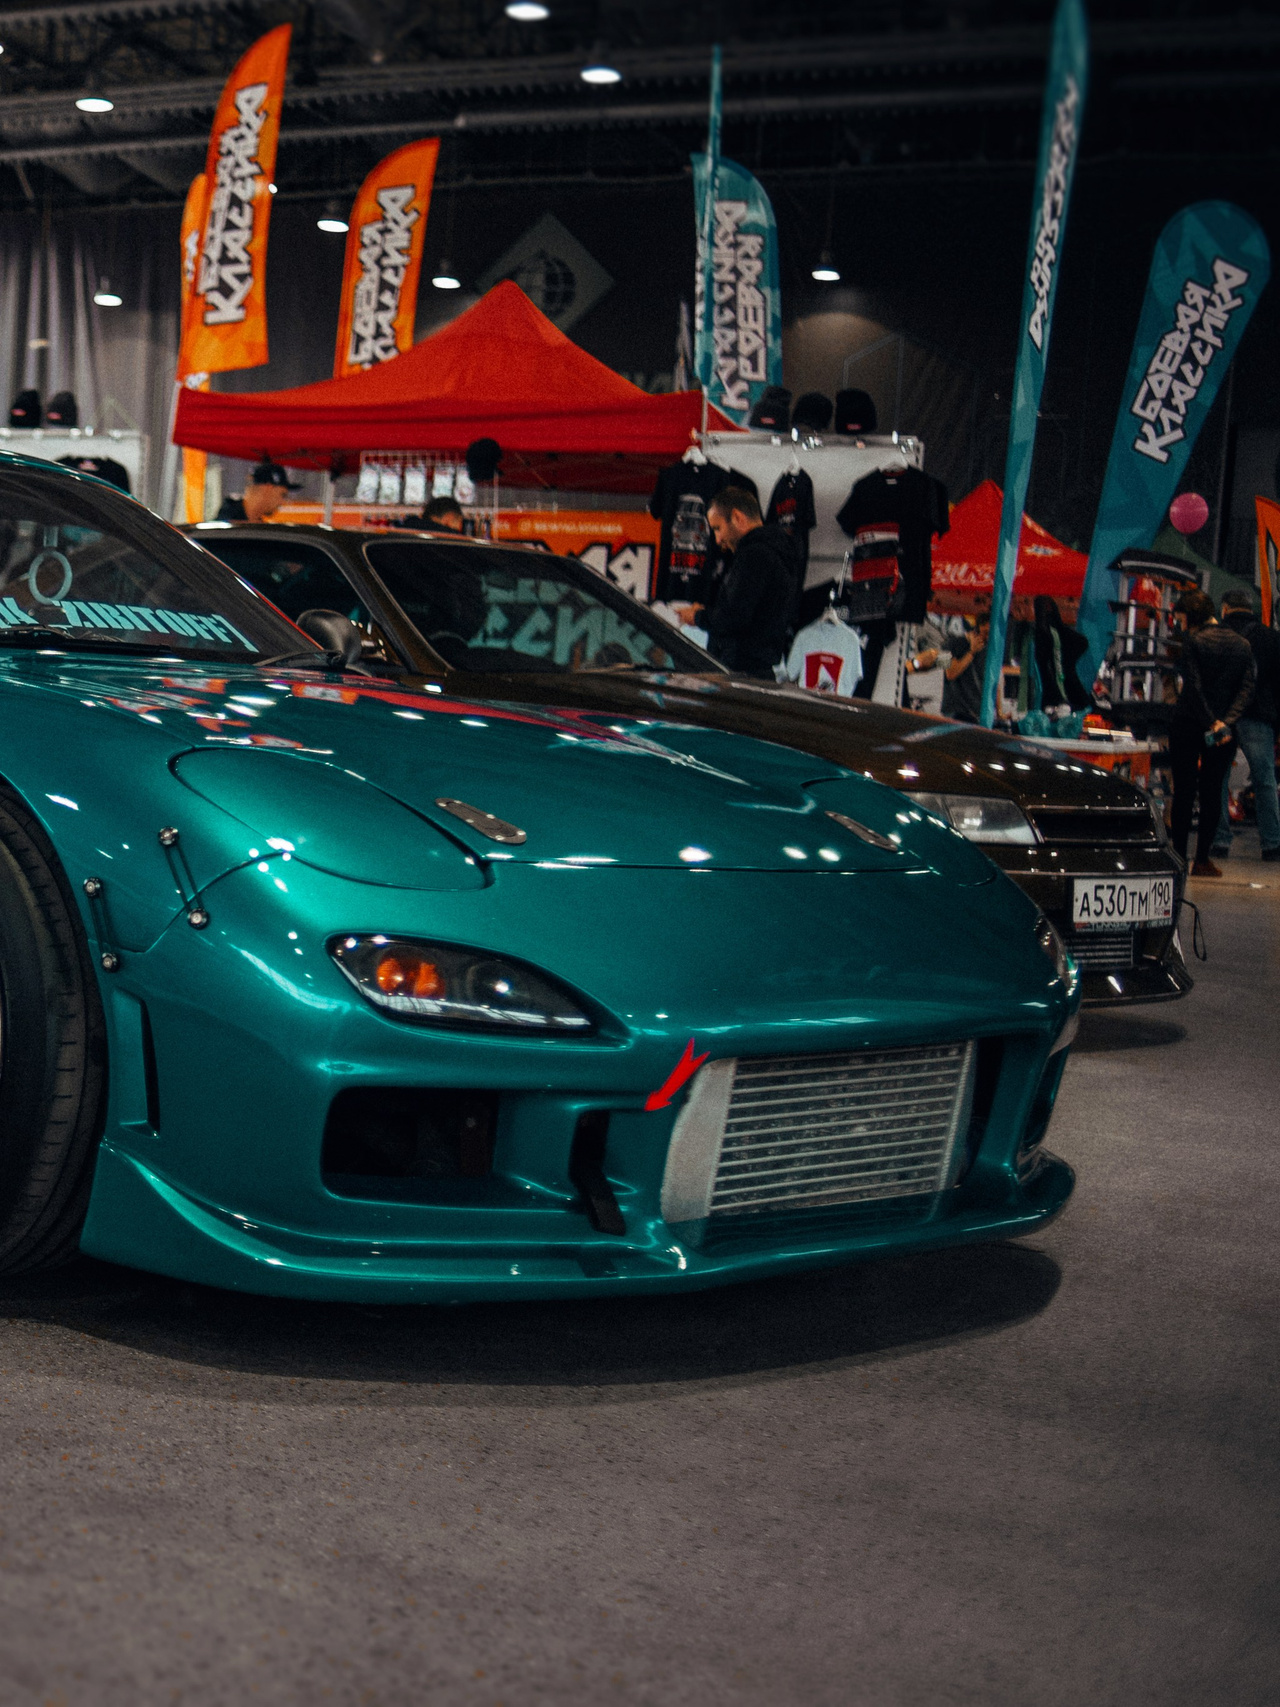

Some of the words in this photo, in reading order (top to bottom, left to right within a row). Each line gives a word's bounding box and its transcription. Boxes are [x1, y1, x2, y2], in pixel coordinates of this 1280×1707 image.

[361, 183, 420, 371] ЛАССИКА
[1131, 280, 1212, 423] БОЕВАЯ
[1134, 258, 1249, 463] КЛАССИКА
[1151, 881, 1171, 906] 190
